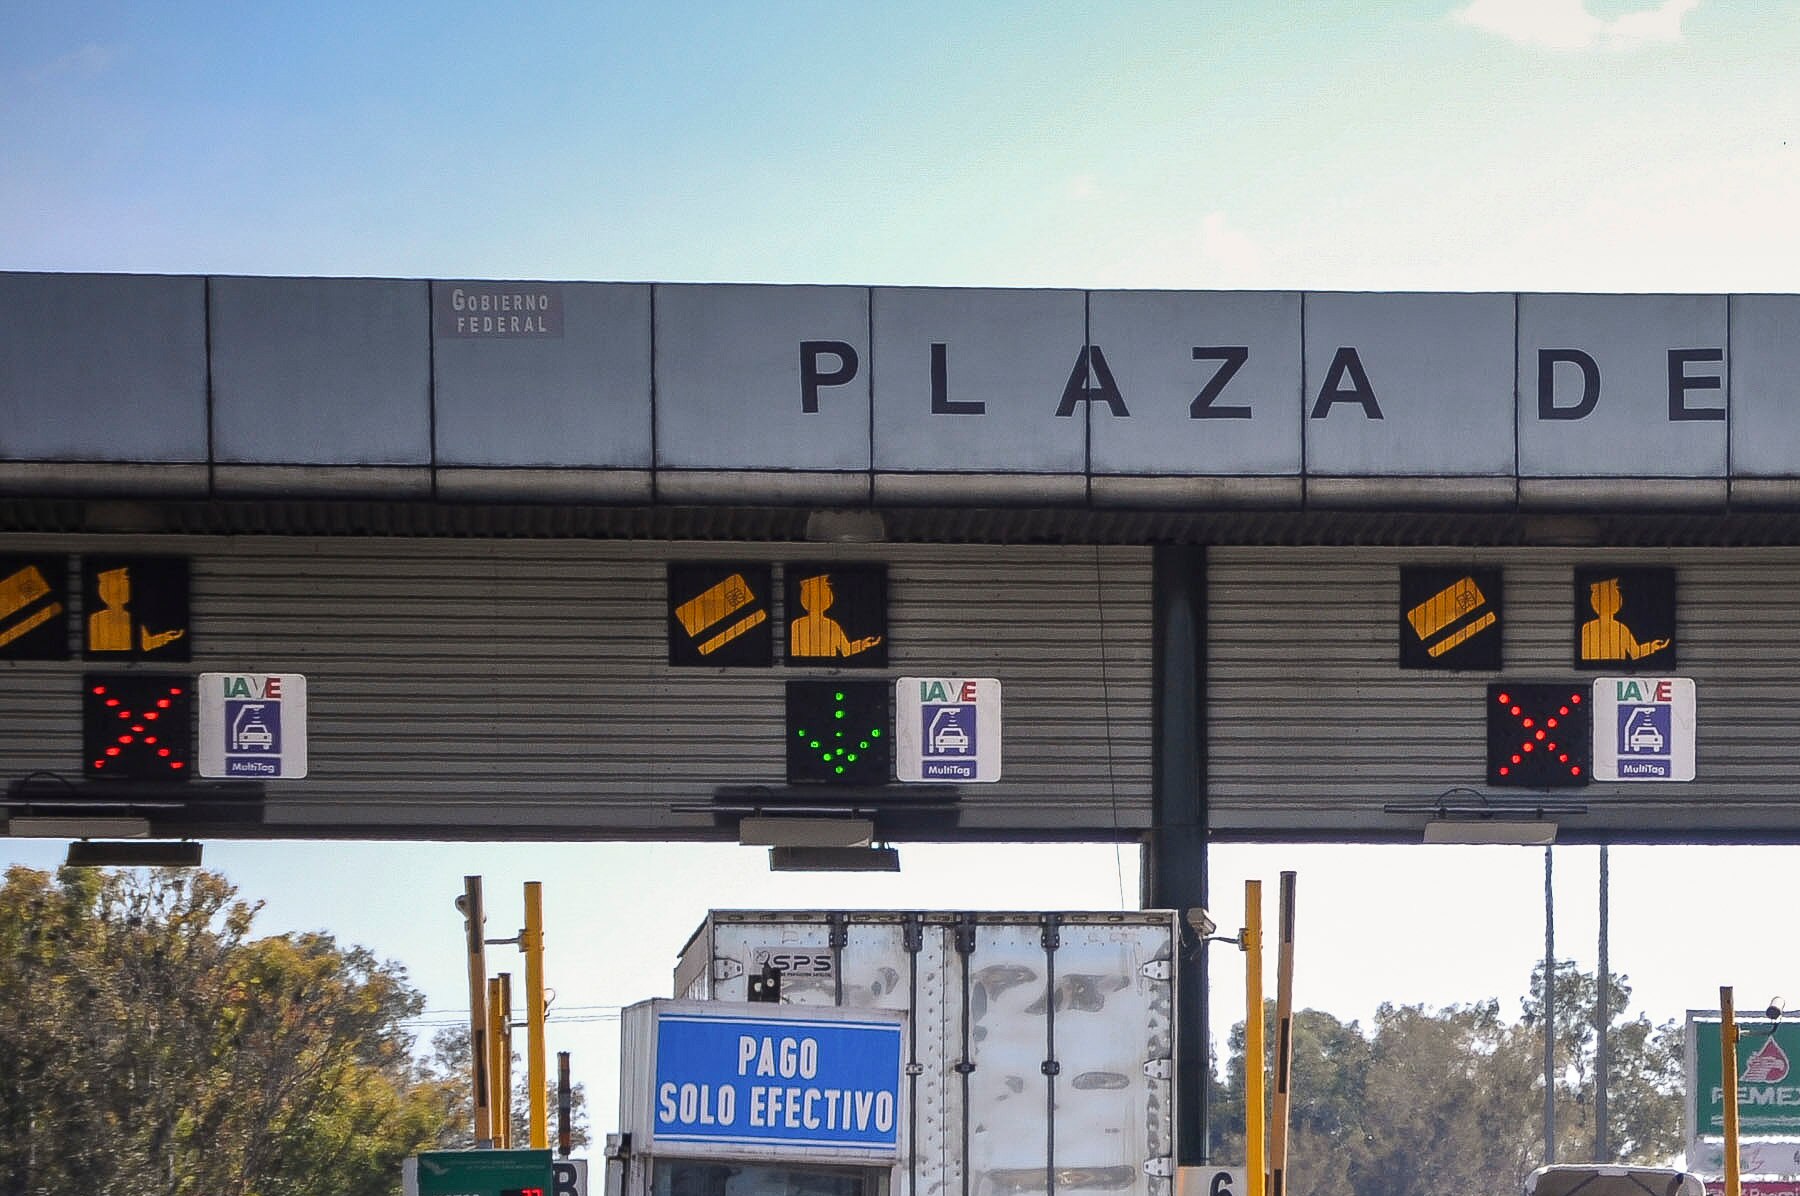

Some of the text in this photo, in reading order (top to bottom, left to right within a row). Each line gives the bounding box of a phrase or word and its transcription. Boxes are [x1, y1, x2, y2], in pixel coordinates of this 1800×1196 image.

[457, 316, 547, 333] FEDERAL
[801, 340, 1385, 420] PLAZA
[1538, 347, 1725, 422] DE
[223, 677, 282, 699] IAVE
[920, 681, 977, 703] IAVE
[1616, 681, 1673, 703] IAVE
[232, 762, 275, 774] MultiTag
[928, 765, 970, 777] MultiTag
[1623, 764, 1665, 776] MultiTag
[773, 955, 832, 972] SPS
[738, 1035, 818, 1080] PAGO
[659, 1082, 894, 1133] SOLO EFECTIVO
